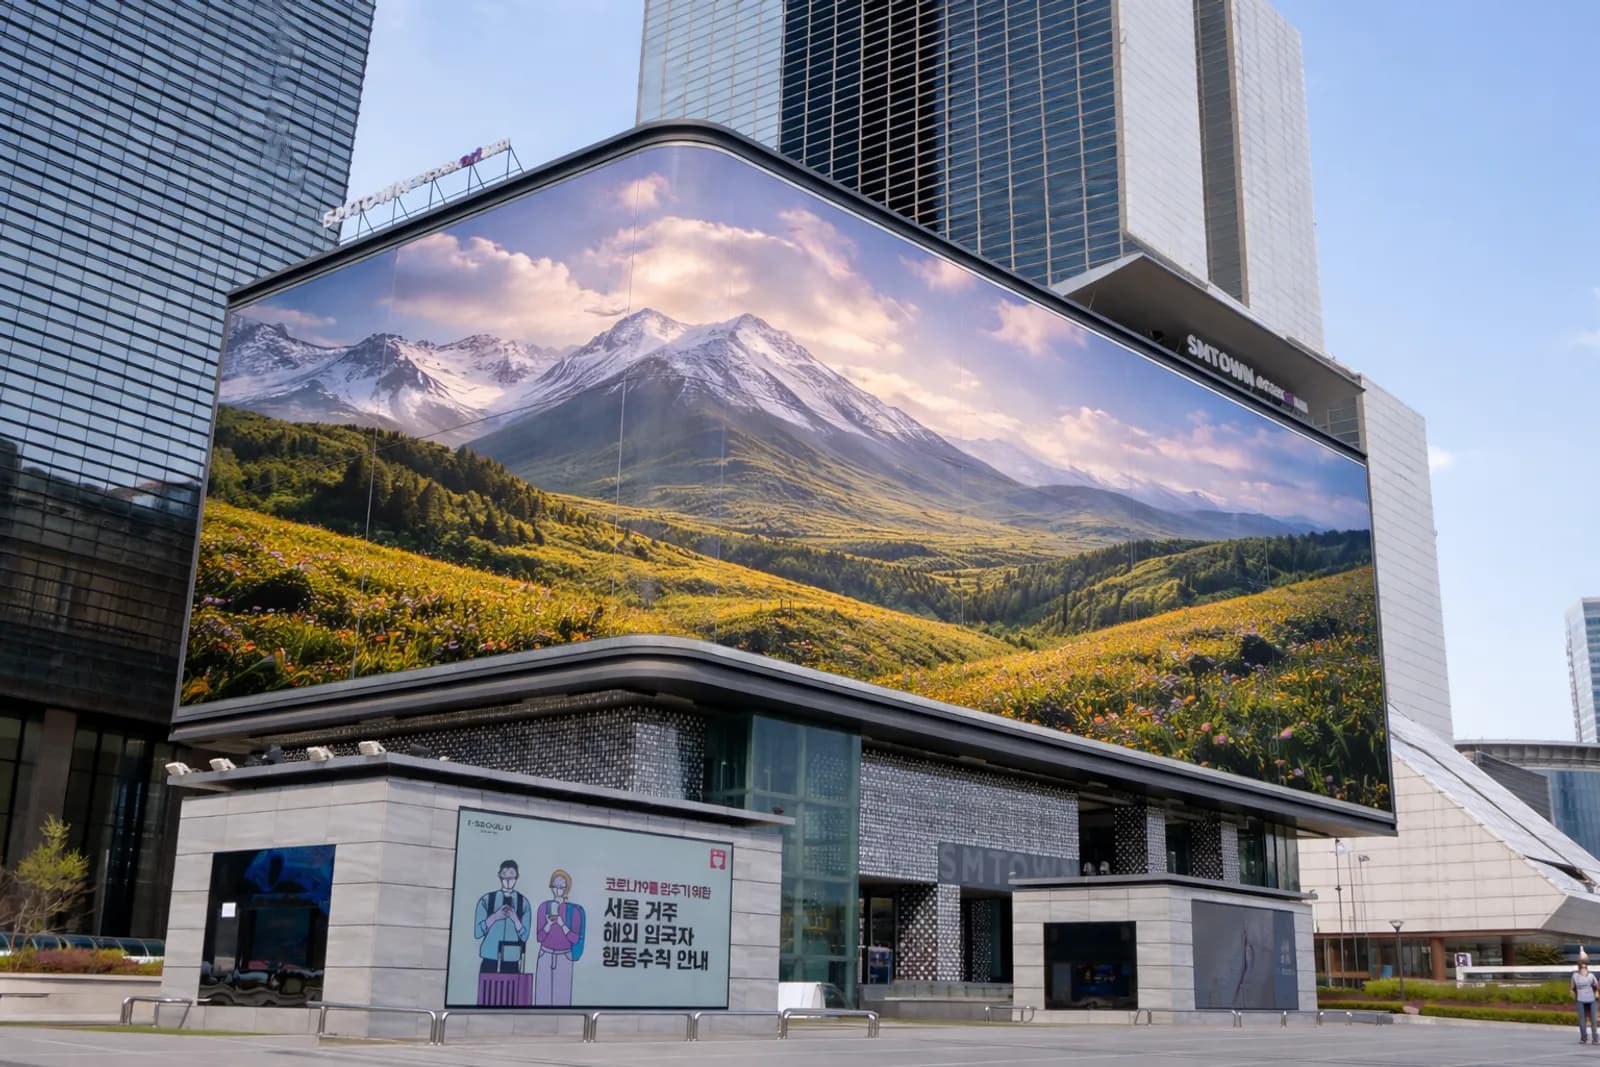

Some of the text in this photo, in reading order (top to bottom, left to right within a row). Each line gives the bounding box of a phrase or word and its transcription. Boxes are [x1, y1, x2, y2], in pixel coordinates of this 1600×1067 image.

[1187, 334, 1255, 387] SMTOWN
[604, 897, 678, 922] 서울 거주
[603, 921, 694, 946] 해외 입국자
[602, 946, 708, 971] 행동수칙 안내
